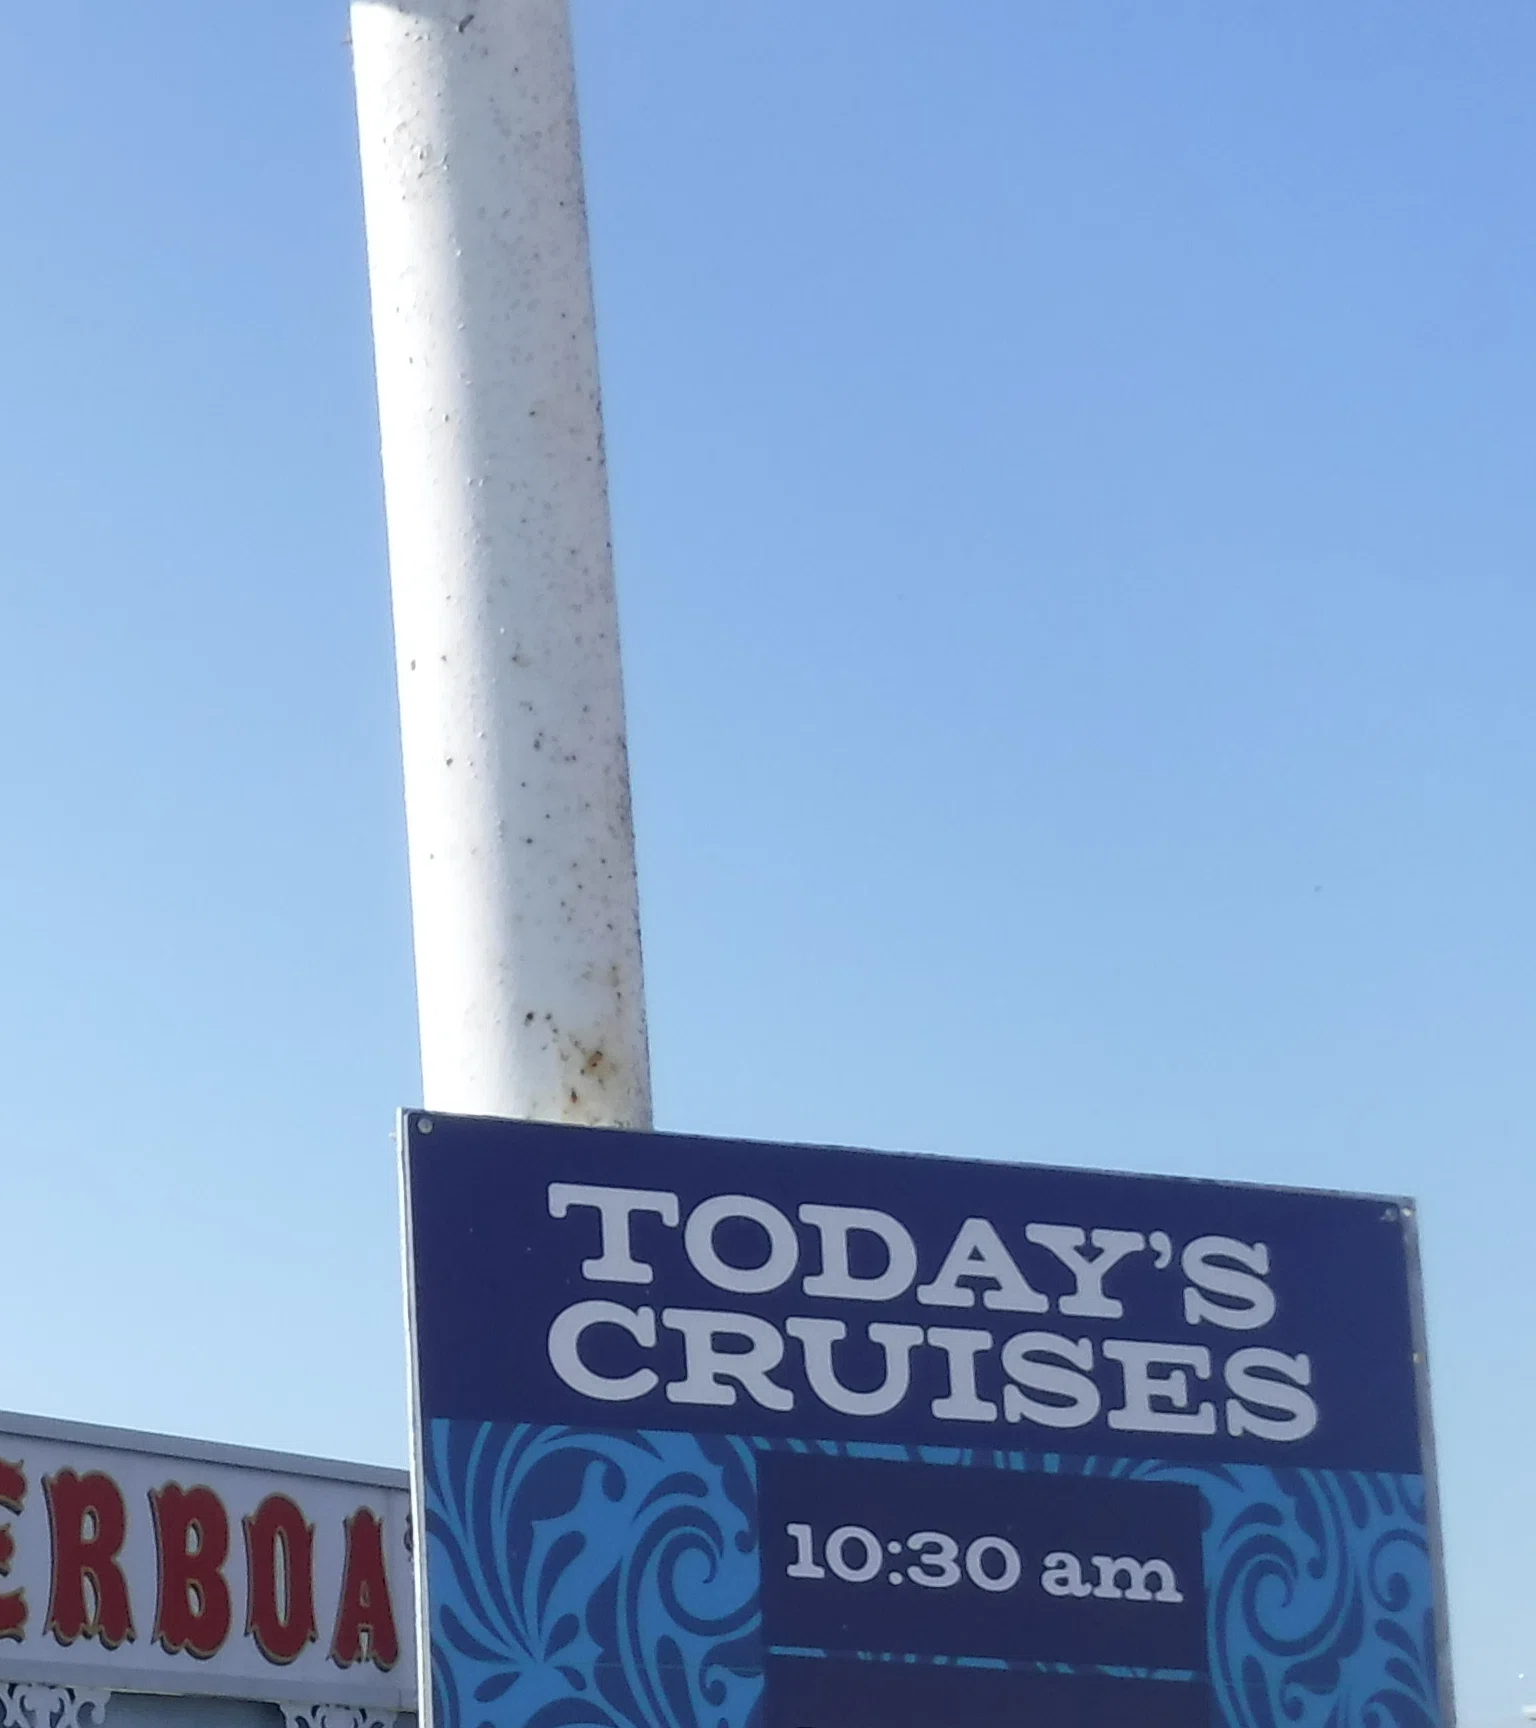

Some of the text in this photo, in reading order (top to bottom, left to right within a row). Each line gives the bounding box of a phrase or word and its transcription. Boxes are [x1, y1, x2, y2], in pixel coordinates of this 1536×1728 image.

[547, 1182, 1279, 1331] TODAY'S
[547, 1299, 1321, 1442] CRUISES
[786, 1522, 1184, 1604] 10:30 am
